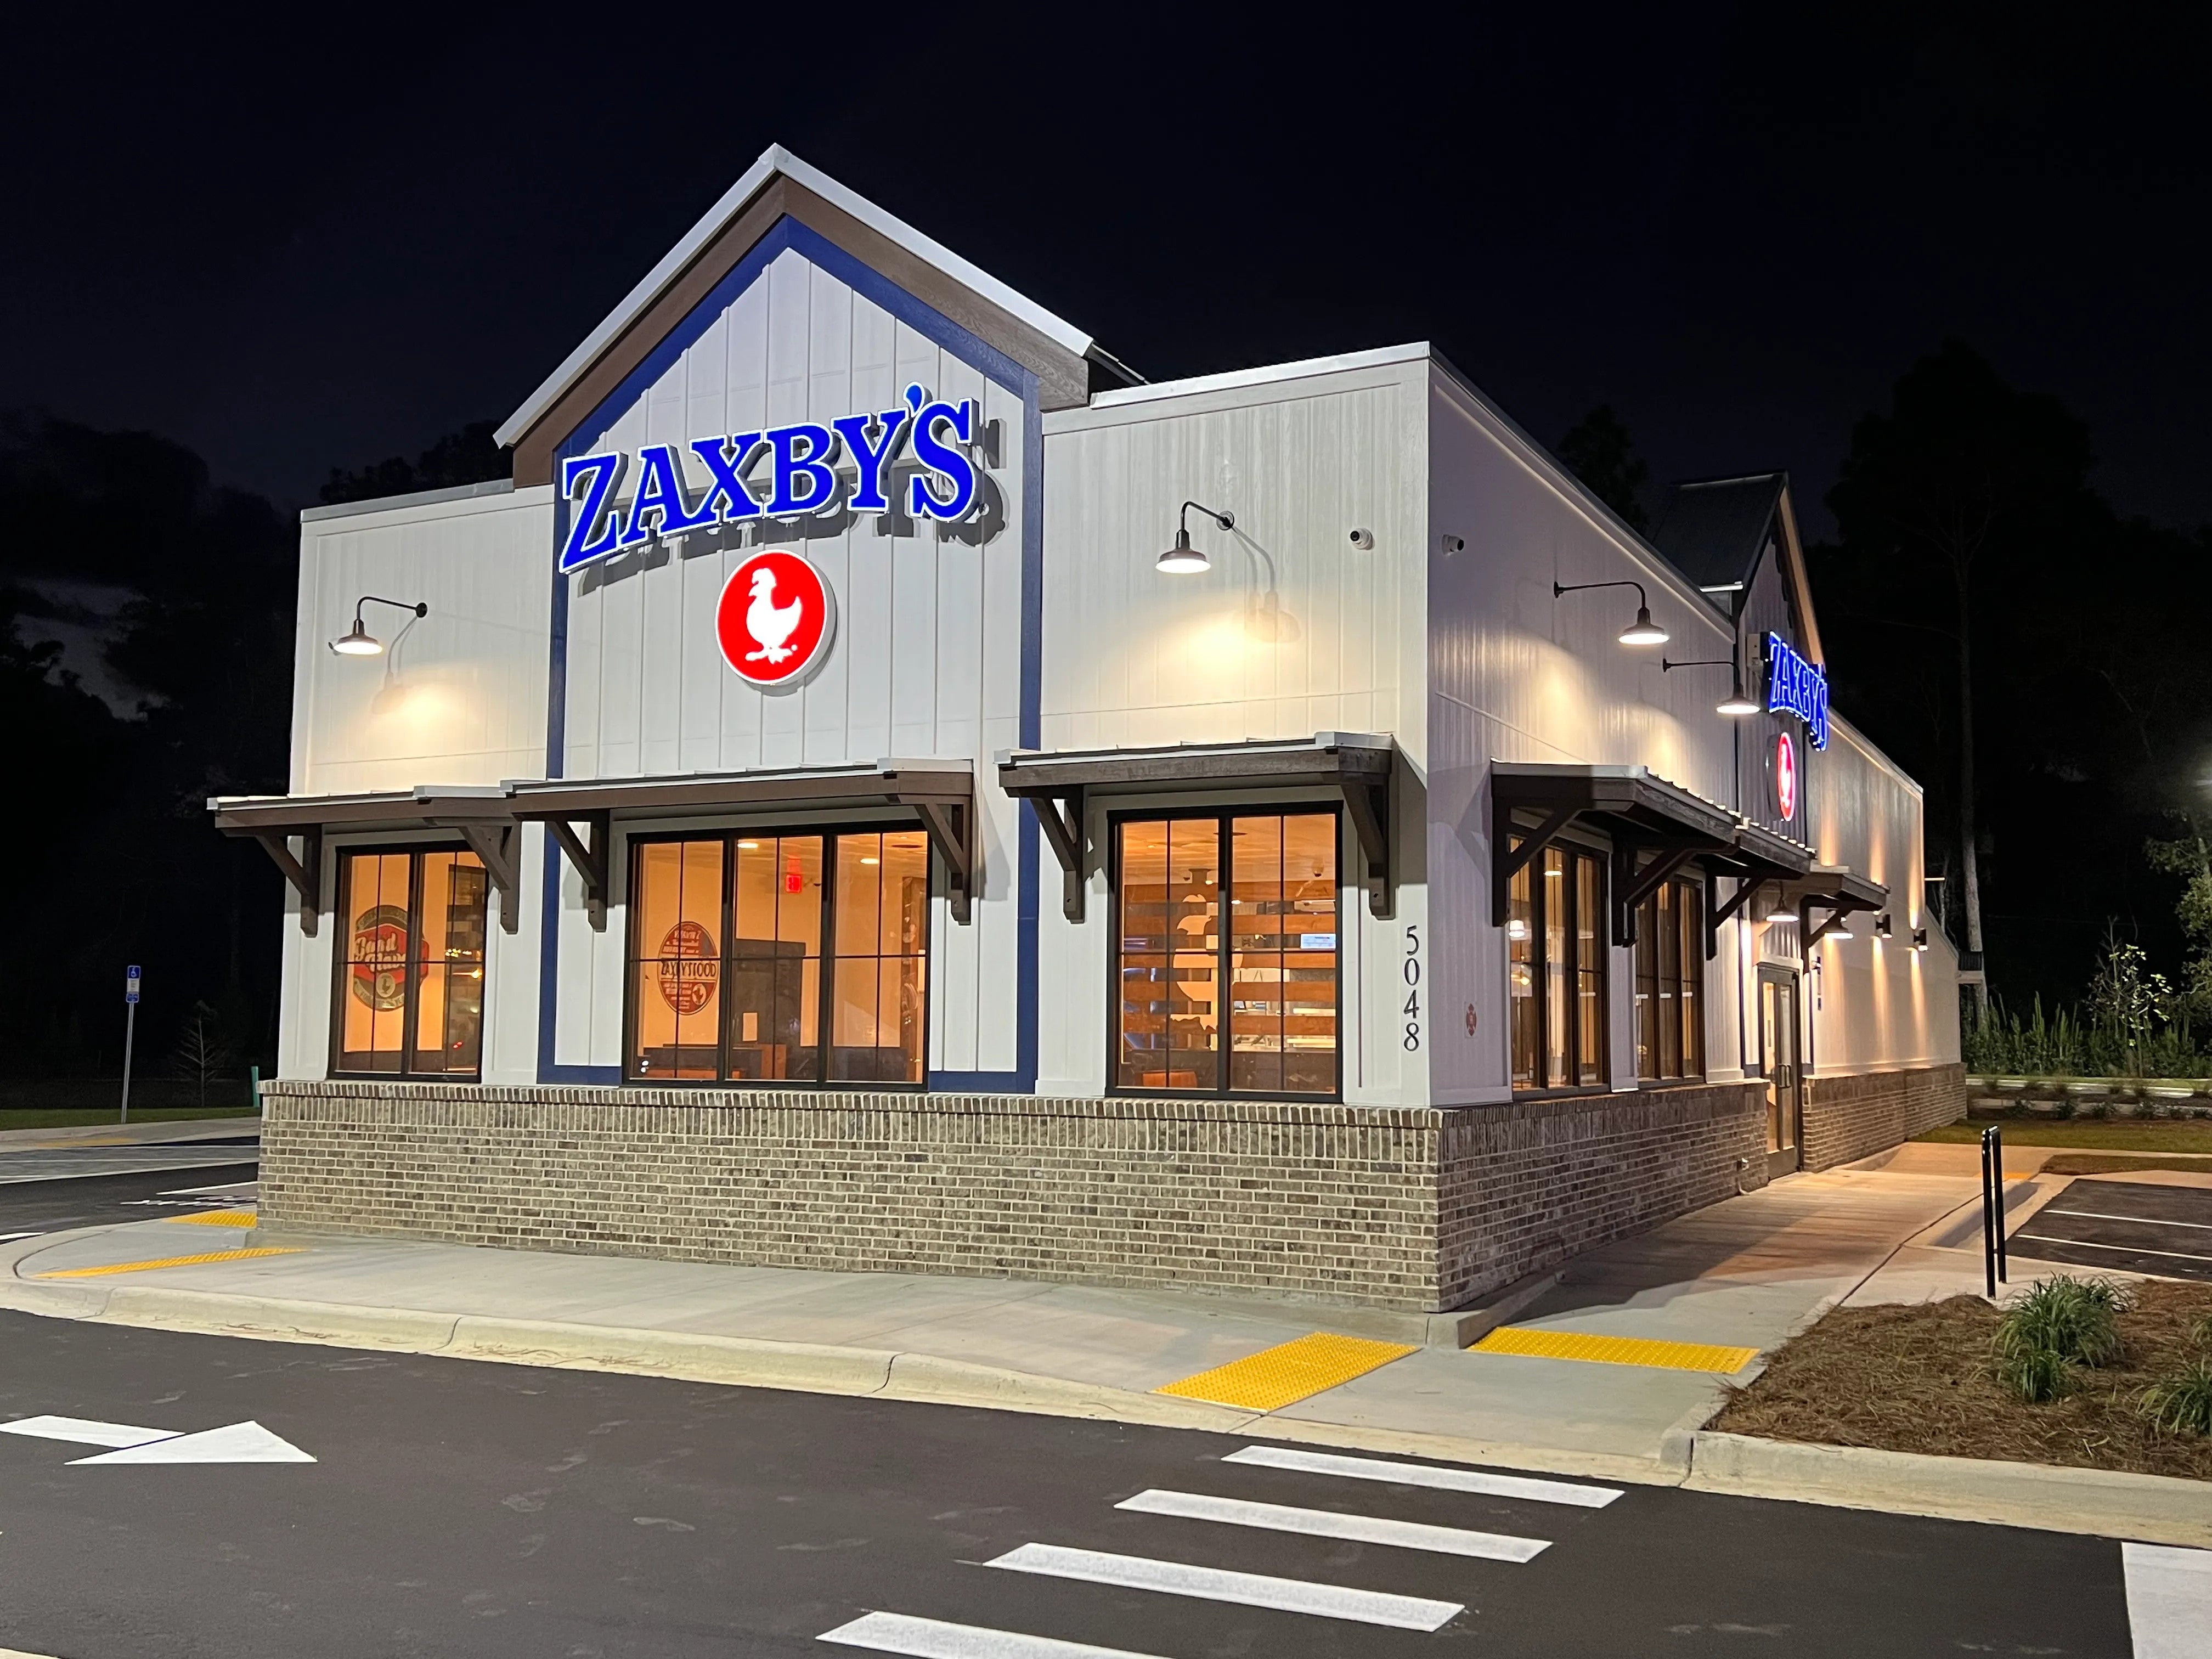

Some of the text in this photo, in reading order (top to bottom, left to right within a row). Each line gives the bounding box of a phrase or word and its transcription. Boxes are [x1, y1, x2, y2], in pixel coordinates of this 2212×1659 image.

[559, 382, 977, 573] ZAXBY'S
[1769, 631, 1828, 751] ZAXBY'S
[1403, 925, 1420, 1052] 5048
